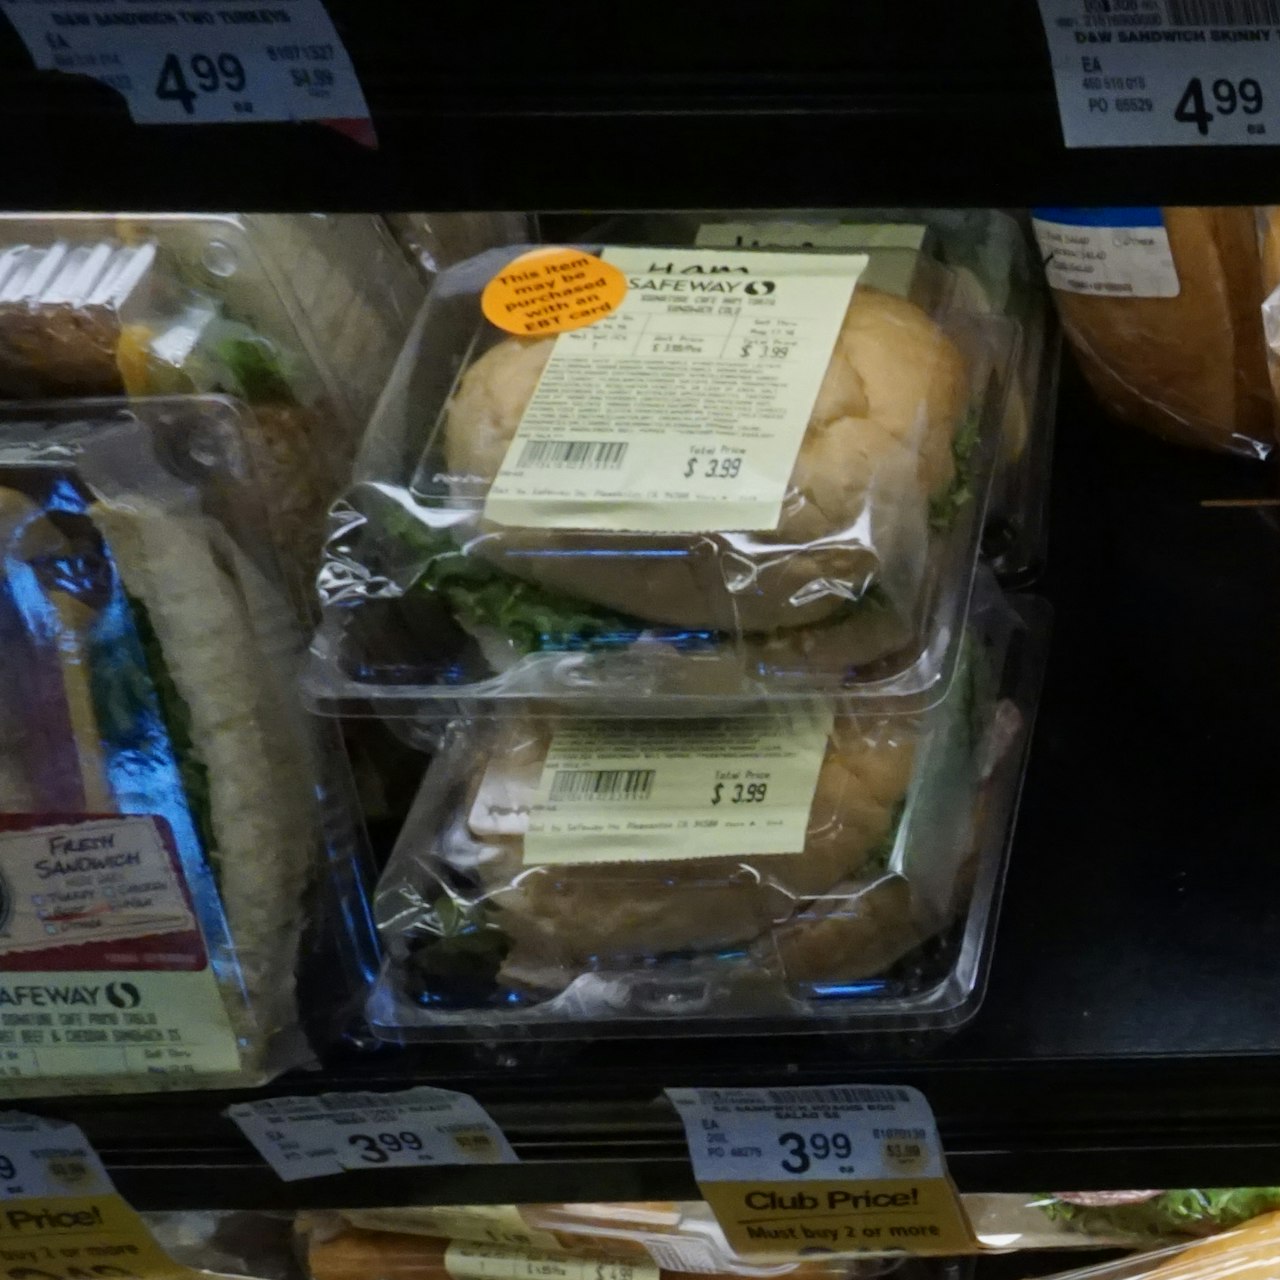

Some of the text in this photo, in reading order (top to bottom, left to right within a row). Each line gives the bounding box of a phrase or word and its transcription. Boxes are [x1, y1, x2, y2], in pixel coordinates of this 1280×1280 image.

[1118, 29, 1205, 43] SANDWICH
[1210, 30, 1270, 41] SKINNY
[1081, 57, 1102, 73] EA
[500, 258, 589, 286] This item
[514, 272, 586, 295] may be
[629, 278, 742, 293] SAFEWAY
[505, 277, 607, 313] purchased
[525, 301, 611, 331] EBT card
[526, 294, 600, 318] with an
[705, 458, 741, 479] 3.99
[733, 783, 767, 802] 3.99
[50, 834, 114, 855] FRESH
[35, 852, 140, 878] SANDWICH
[745, 1188, 919, 1210] Club Price!
[747, 1225, 940, 1241] Must buy or more
